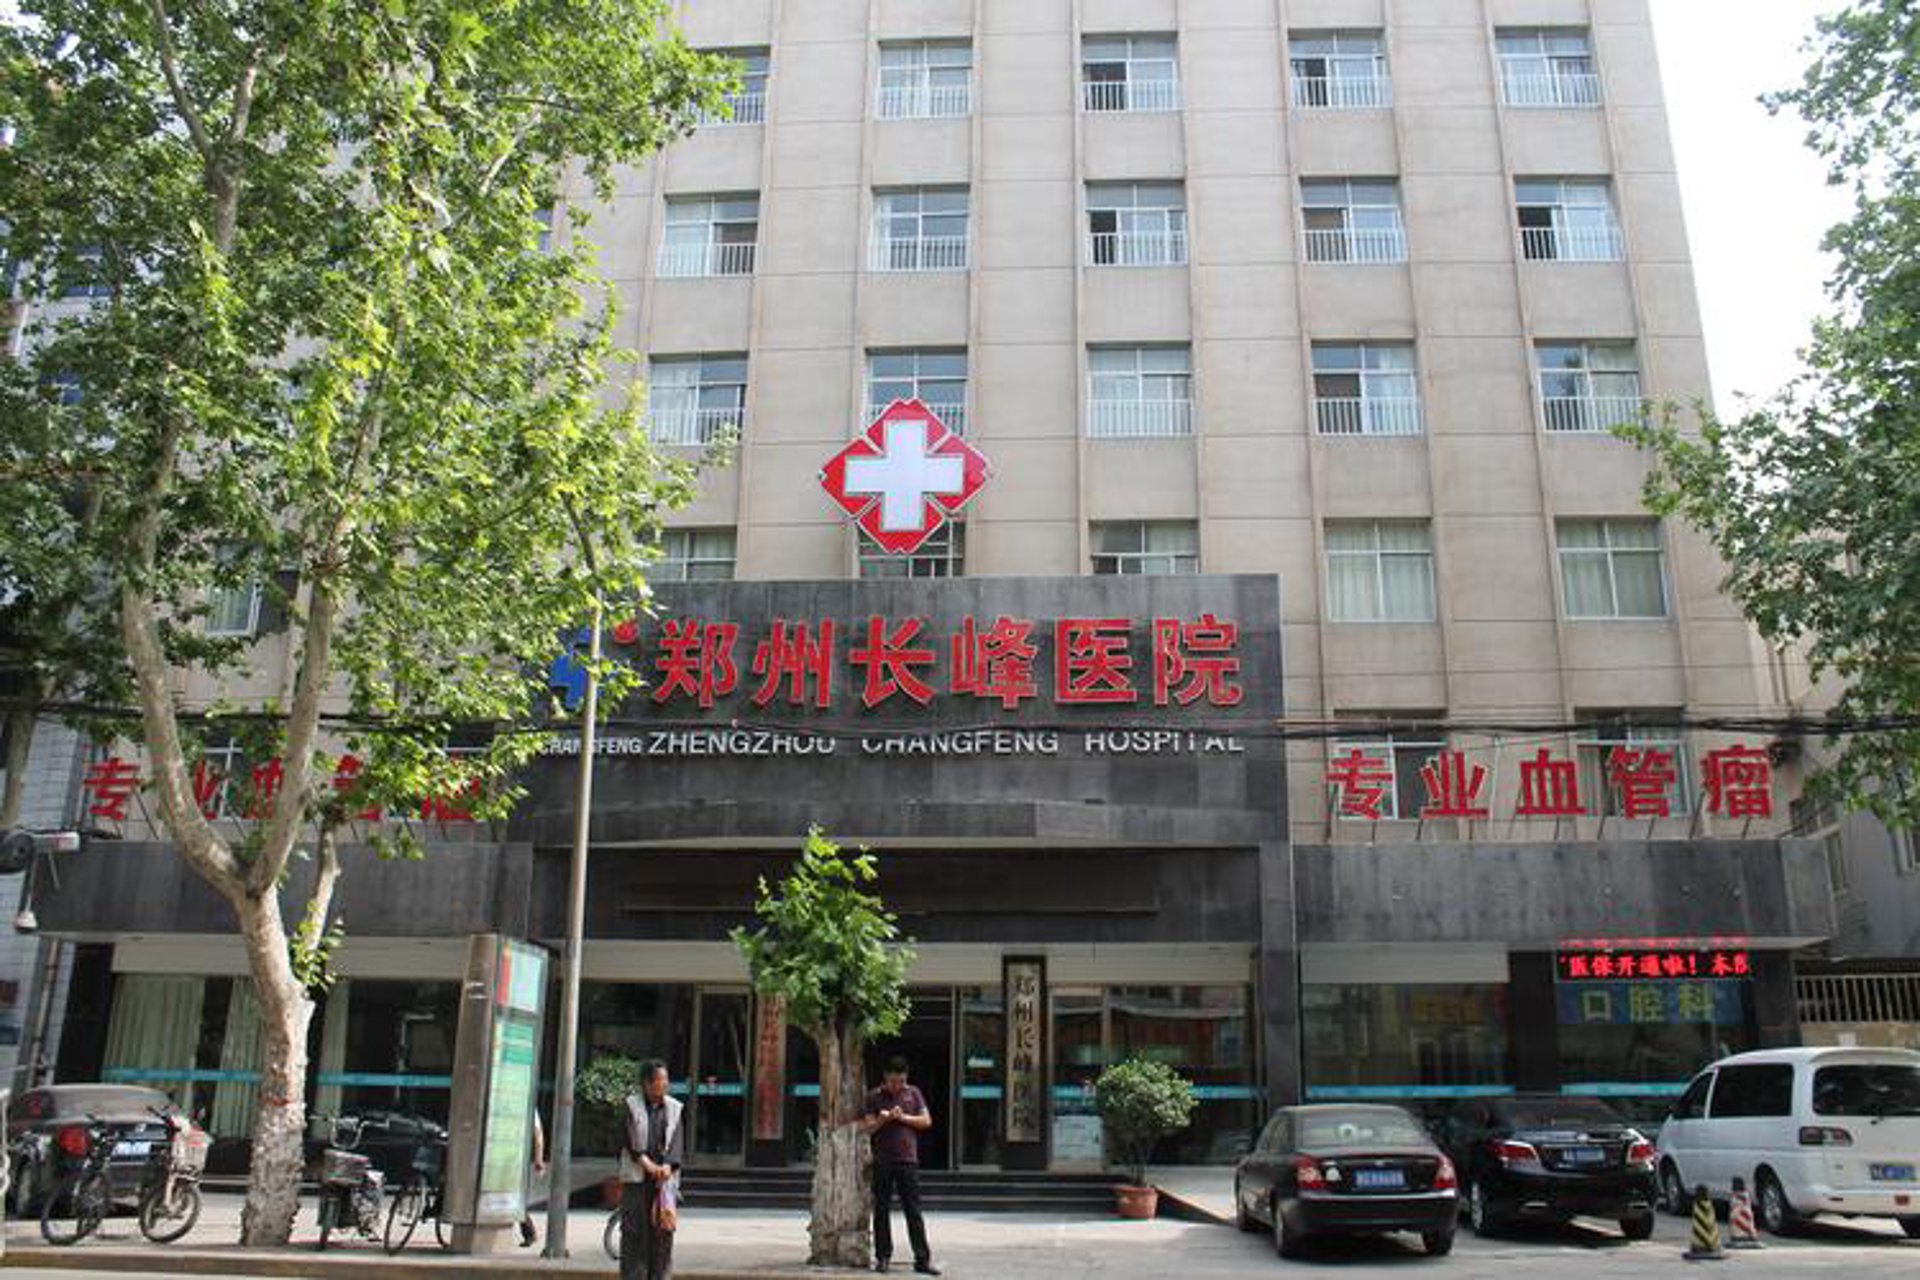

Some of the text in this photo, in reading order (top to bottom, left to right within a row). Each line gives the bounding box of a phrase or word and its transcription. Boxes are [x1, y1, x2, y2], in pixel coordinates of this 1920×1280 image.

[653, 614, 1244, 709] 郑州长峰医院
[650, 731, 836, 755] ZHENGZHOU
[861, 731, 1059, 754] CHANGFENG
[1327, 744, 1772, 820] 专业血管瘤
[1582, 983, 1716, 1022] 口腔科
